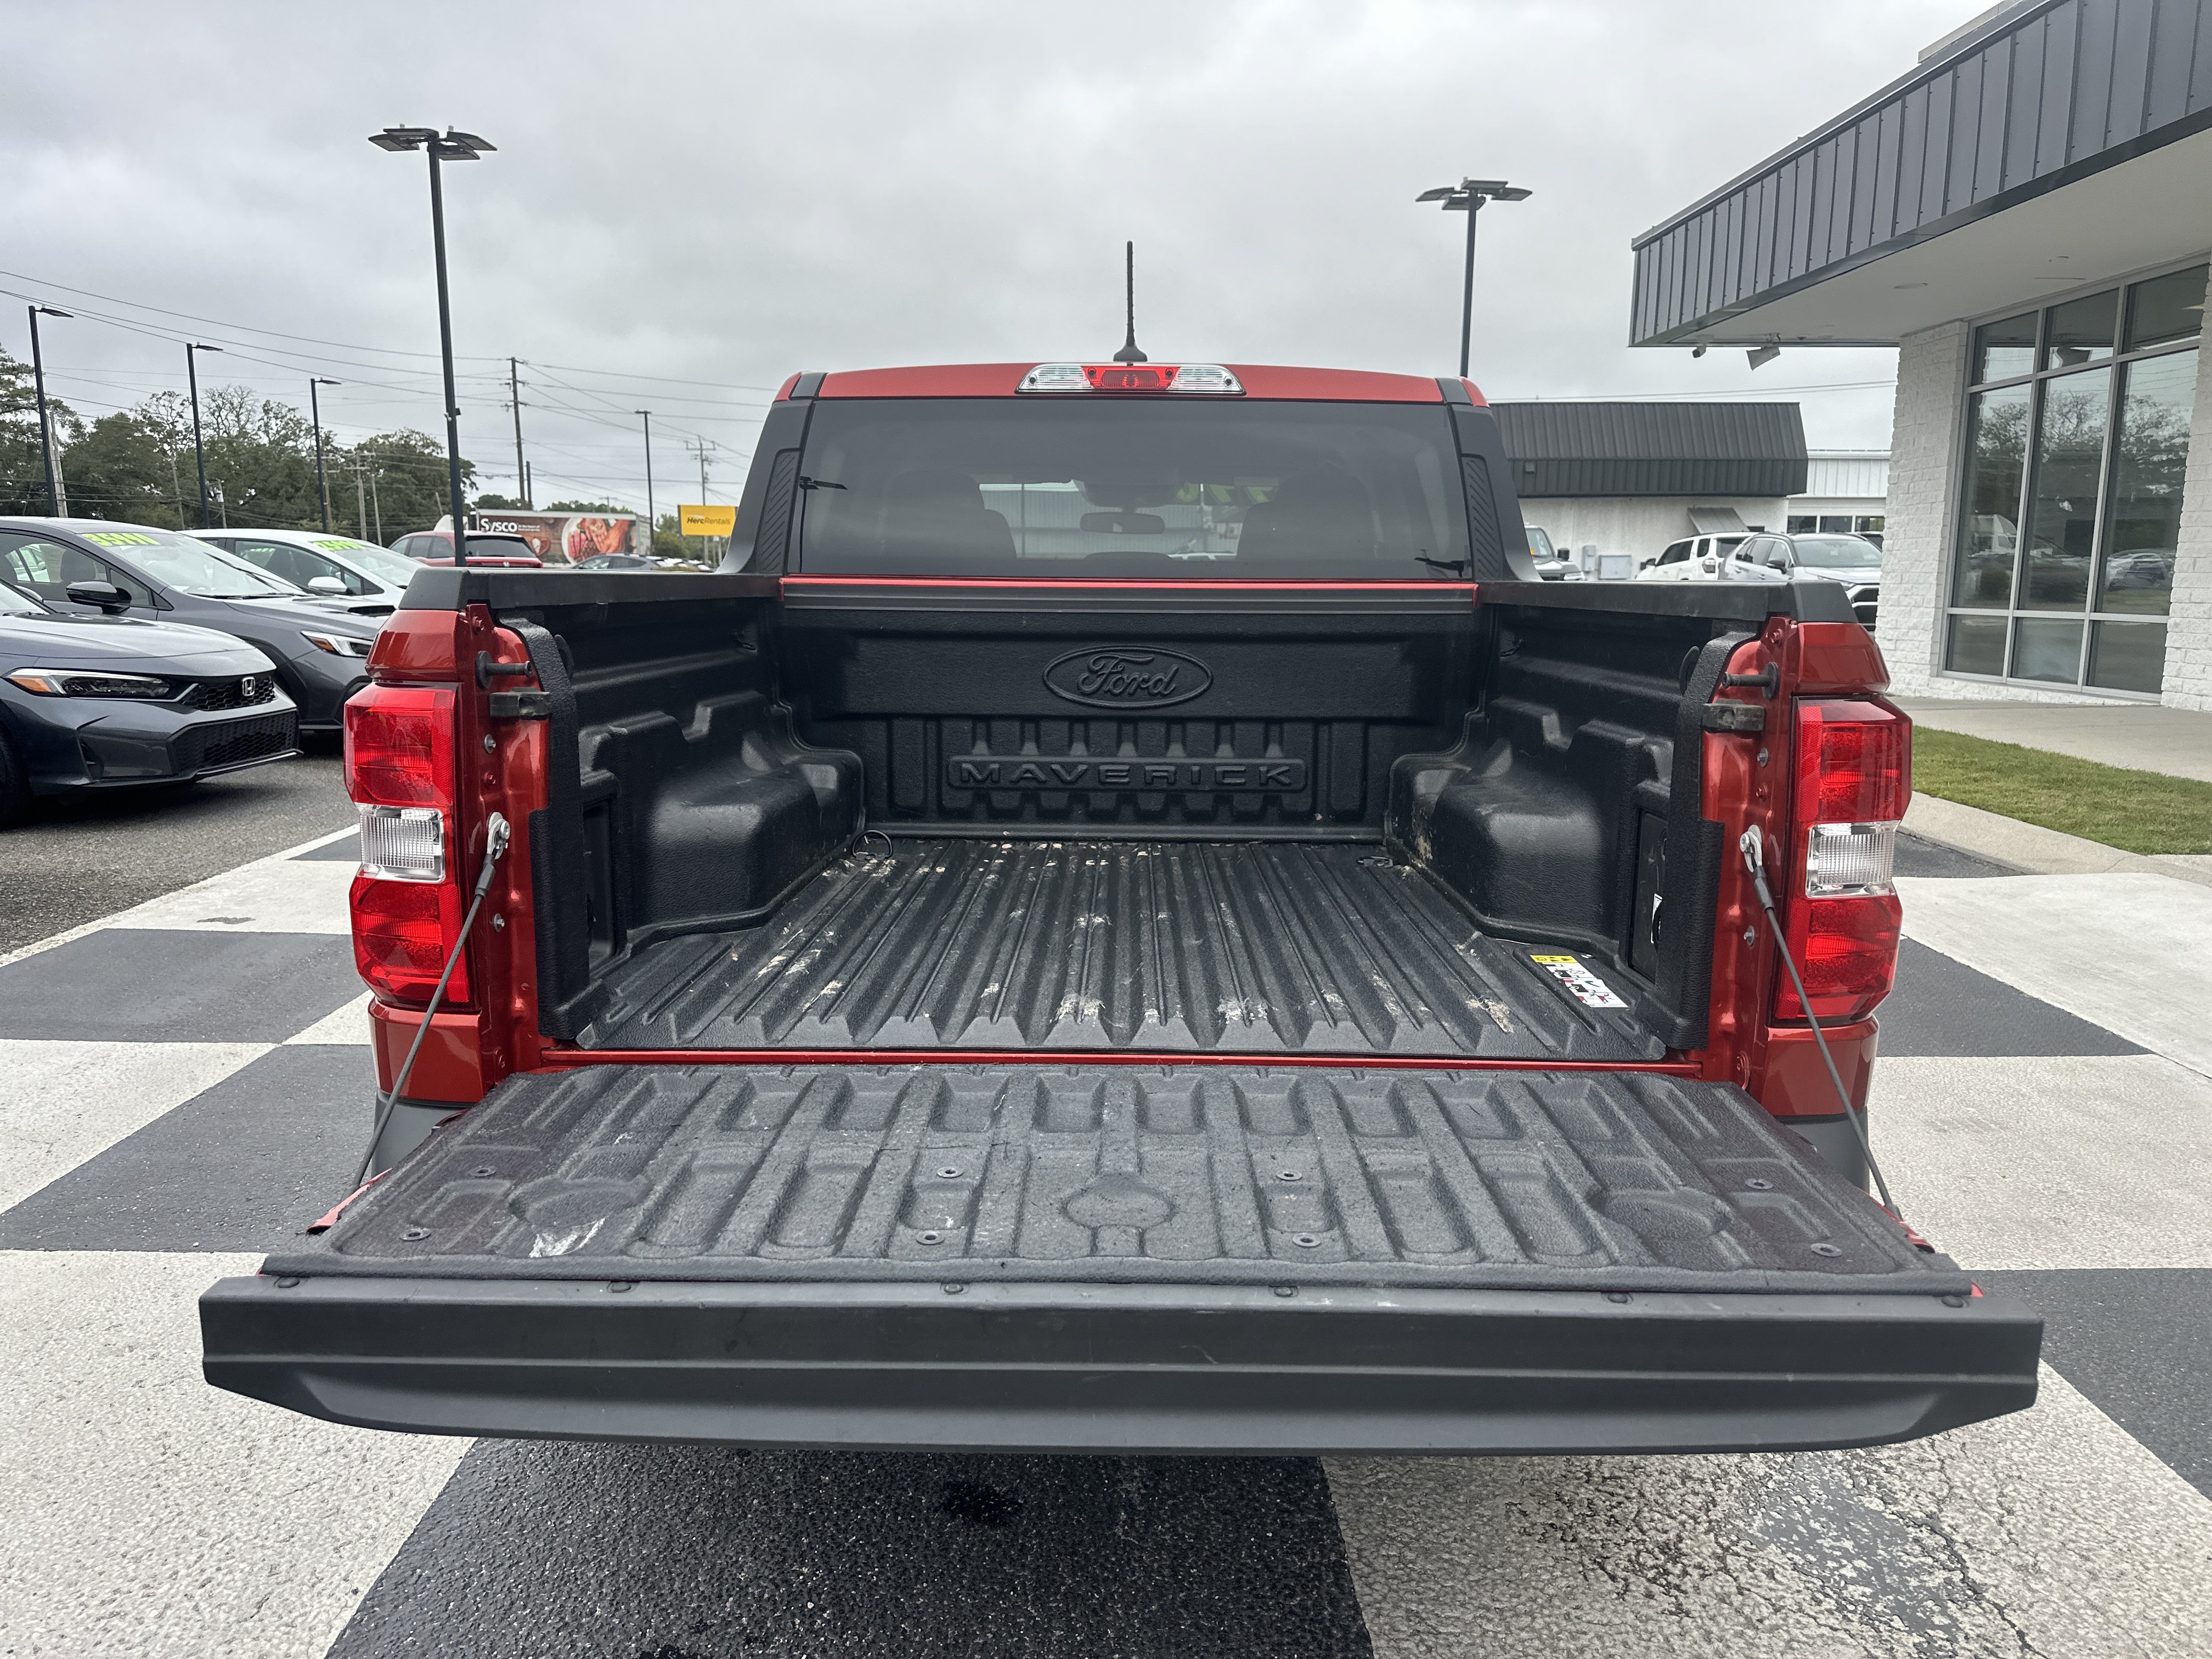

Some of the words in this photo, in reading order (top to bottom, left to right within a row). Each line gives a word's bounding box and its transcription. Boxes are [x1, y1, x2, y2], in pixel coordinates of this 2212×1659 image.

[687, 517, 731, 525] HercRentals
[82, 533, 161, 547] 35990
[1077, 652, 1179, 696] Ford
[961, 763, 1291, 785] MAVERICK
